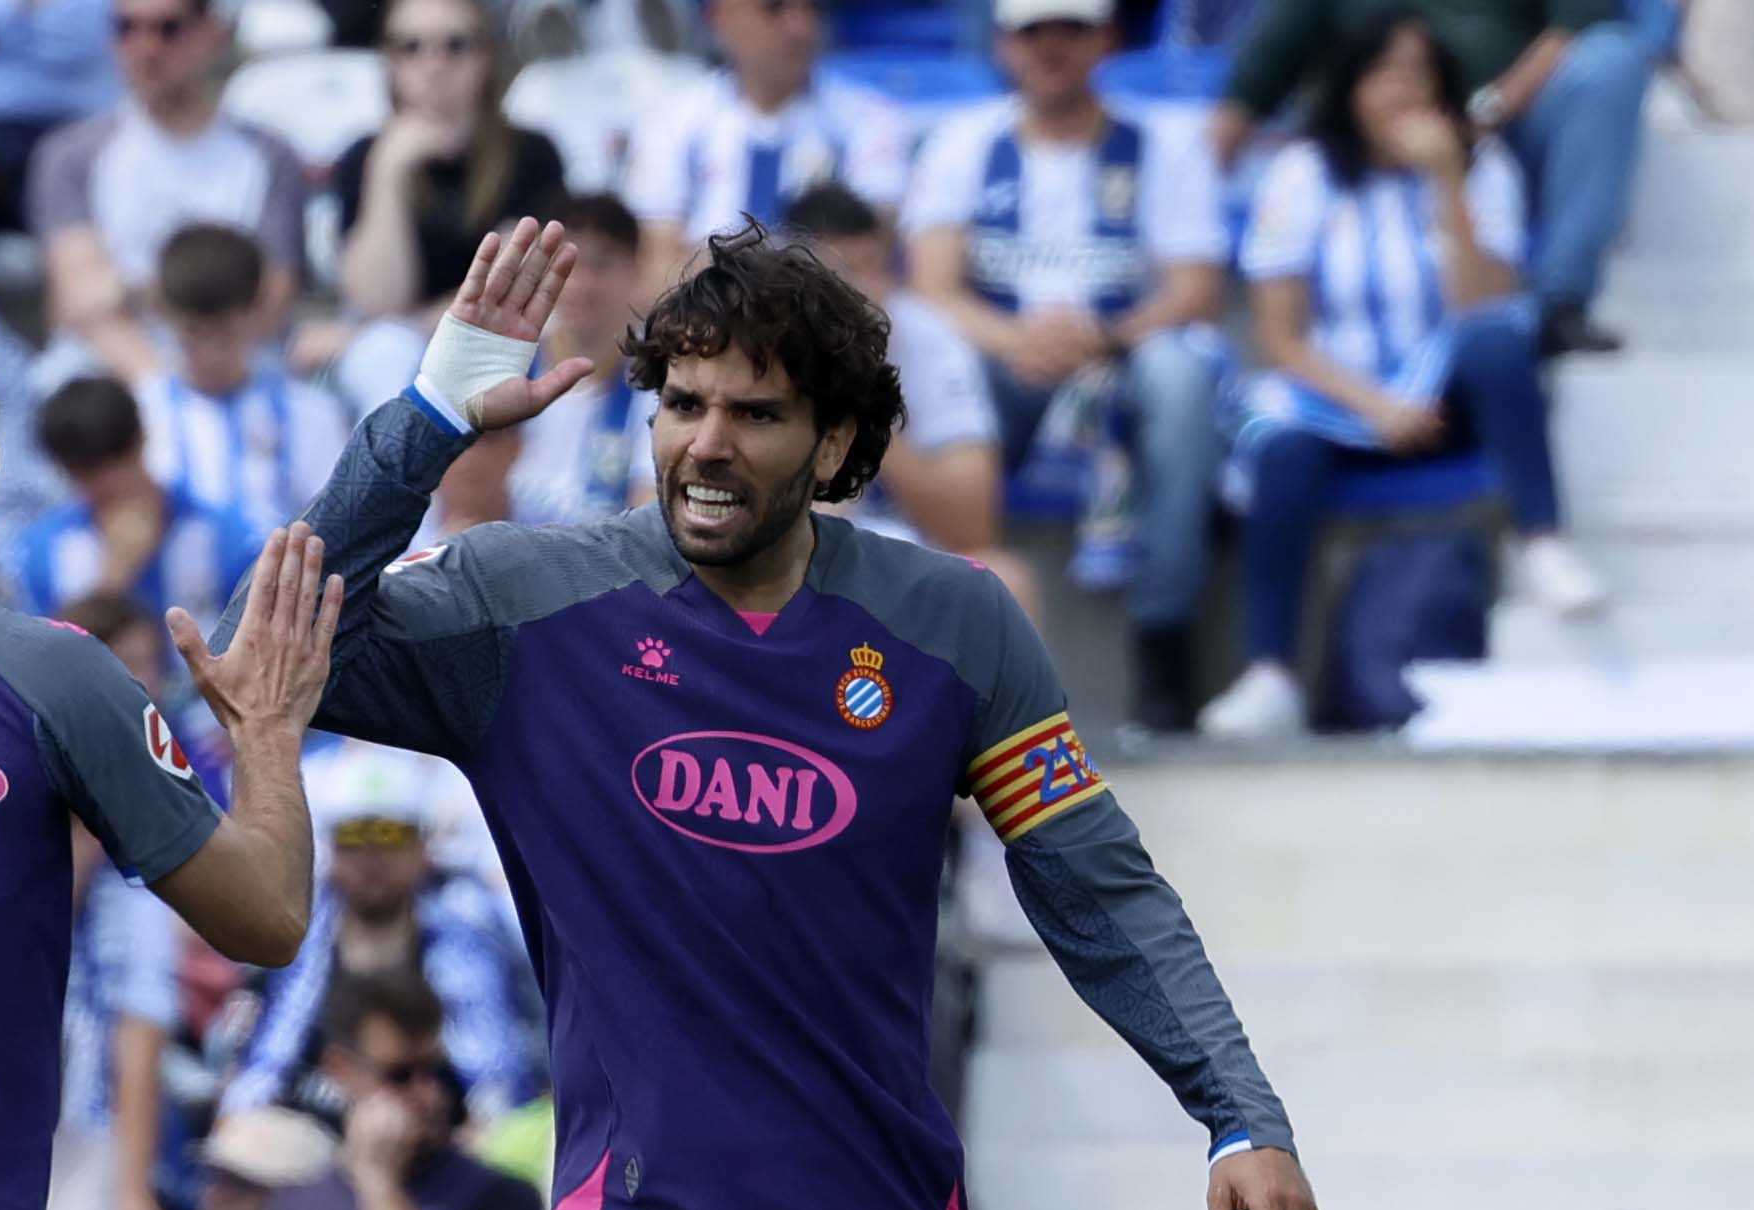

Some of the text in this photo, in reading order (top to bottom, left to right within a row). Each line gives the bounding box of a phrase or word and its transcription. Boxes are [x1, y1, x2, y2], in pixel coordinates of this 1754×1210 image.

[621, 664, 680, 686] KELME
[653, 749, 818, 831] DANI
[1024, 735, 1087, 804] 21
